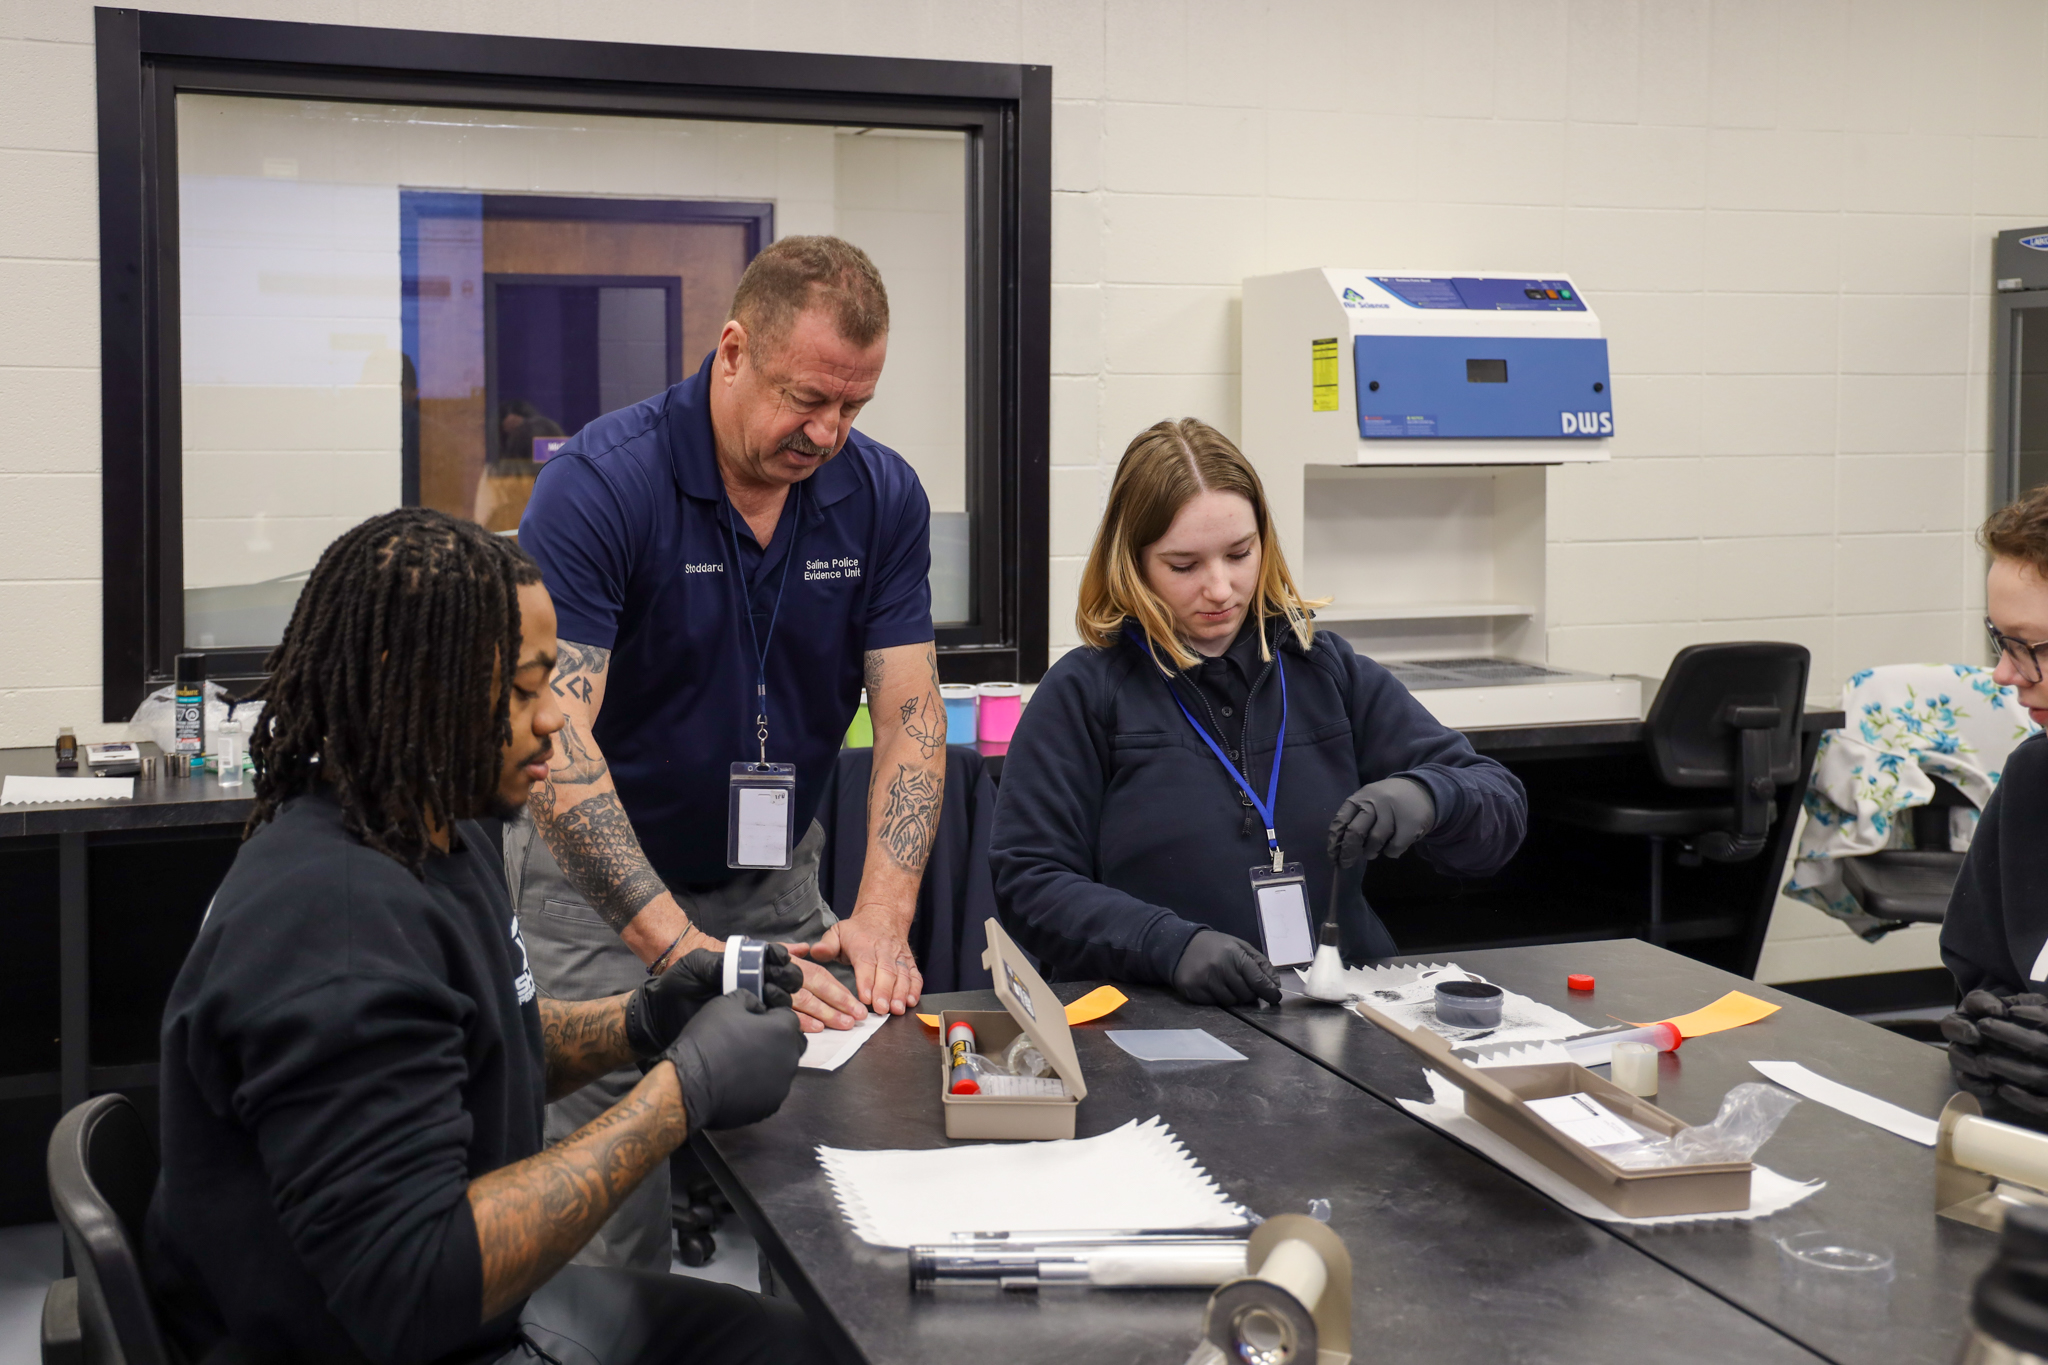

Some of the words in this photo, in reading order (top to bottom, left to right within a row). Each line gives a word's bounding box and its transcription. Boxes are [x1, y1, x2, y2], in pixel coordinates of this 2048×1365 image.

[1561, 411, 1613, 434] DWS
[685, 562, 724, 574] Stoddard
[806, 559, 829, 570] Salina
[832, 556, 859, 568] Police
[804, 570, 841, 581] Evidence
[844, 567, 861, 578] Unit
